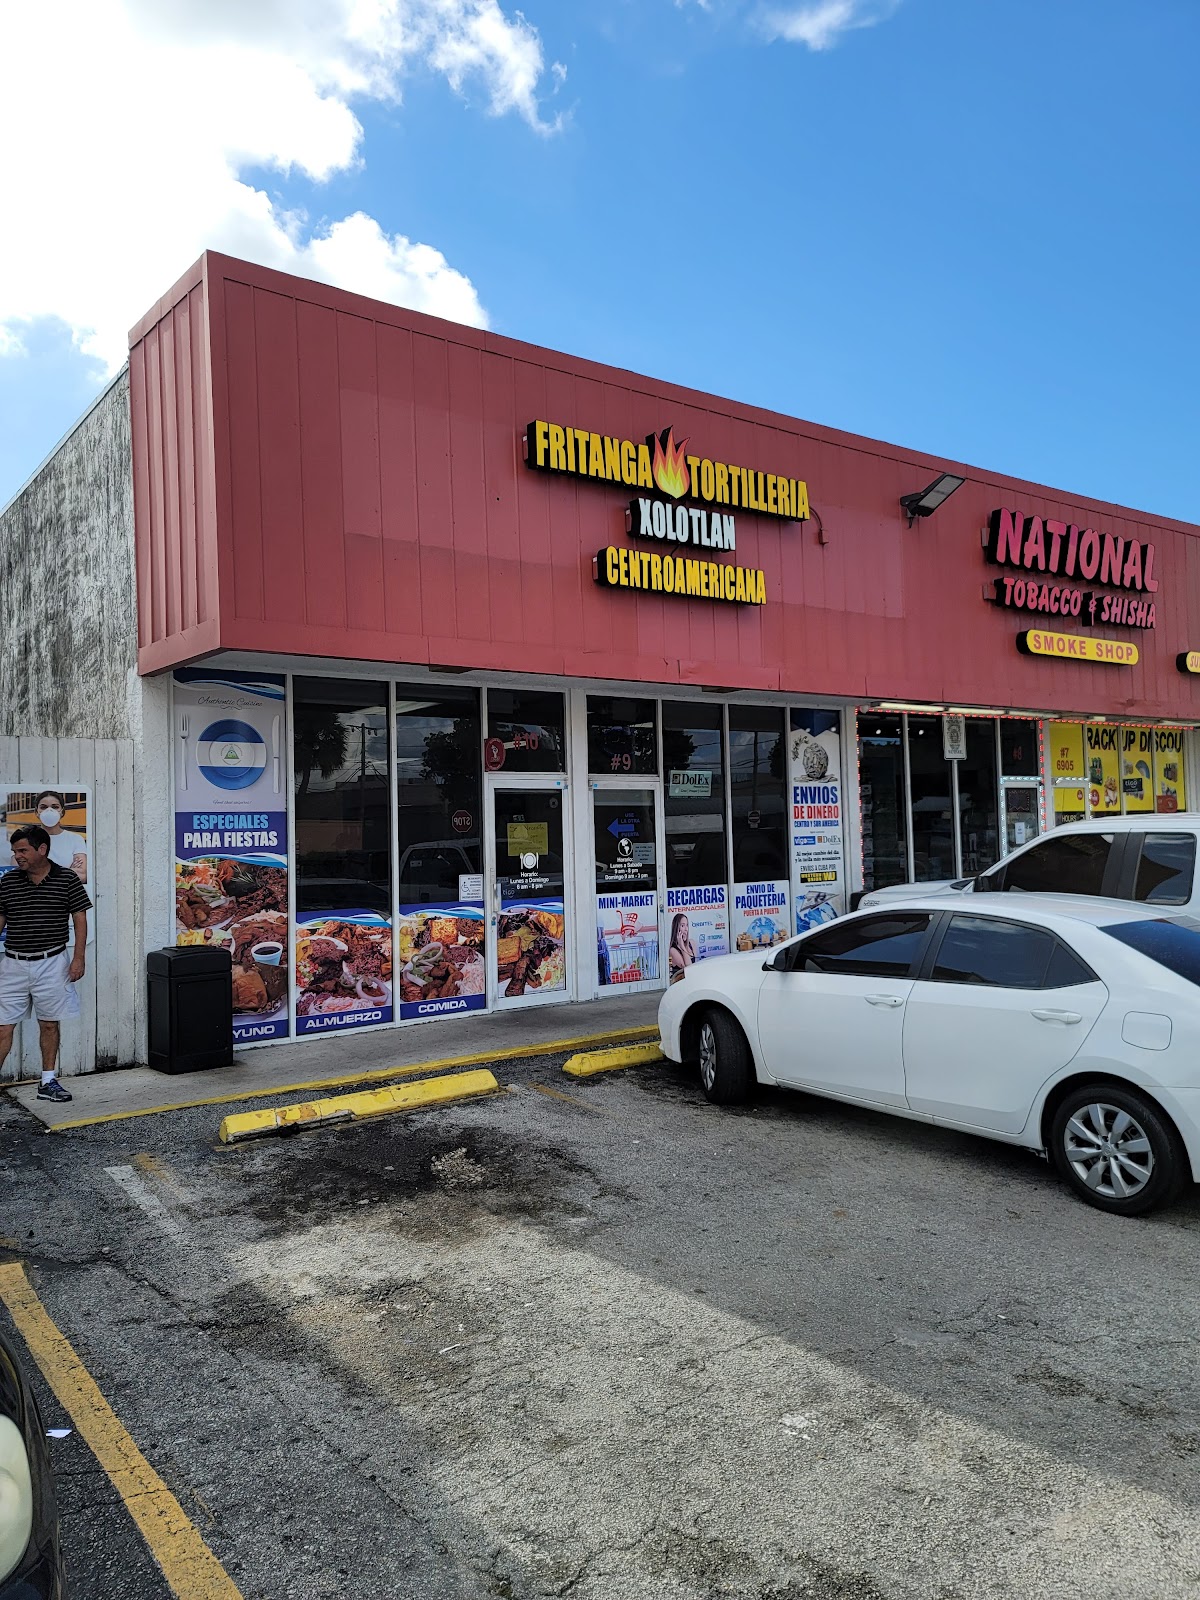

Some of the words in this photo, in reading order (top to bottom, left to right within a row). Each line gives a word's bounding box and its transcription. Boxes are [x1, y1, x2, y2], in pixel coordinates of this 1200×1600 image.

[535, 419, 654, 489] FRITANGA
[687, 455, 811, 520] TORTILLERIA
[638, 497, 736, 551] XOLOTLAN
[996, 507, 1159, 593] NATIONAL
[606, 545, 767, 605] CENTROAMERICANA
[1003, 577, 1081, 616] TOBACCO
[1101, 595, 1156, 629] SHISHA
[1033, 634, 1087, 656] SMOKE
[1096, 643, 1133, 661] SHOP
[1190, 655, 1200, 668] SU
[198, 696, 235, 705] Authentic
[236, 697, 263, 707] Cuisine
[513, 732, 538, 750] #10
[1060, 748, 1069, 759] #7
[611, 753, 631, 770] #9
[1057, 760, 1074, 771] 6905
[682, 773, 710, 785] DolEx
[793, 786, 838, 805] ENVIOS
[793, 806, 804, 819] DE
[807, 805, 839, 819] DINERO
[1061, 814, 1077, 823] HOURS
[193, 814, 269, 829] ESPECIALES
[794, 820, 809, 828] CENTRO
[822, 819, 839, 827] AMERICA
[183, 832, 221, 849] PARA
[224, 831, 278, 848] FIESTAS
[823, 835, 841, 844] DolEx
[746, 884, 766, 894] ENVIO
[767, 883, 775, 892] DE
[598, 895, 654, 909] MINI-MARKET
[667, 887, 725, 907] RECARGAS
[736, 893, 786, 909] PAQUETERIA
[667, 903, 726, 913] INTERNACIONALES
[743, 909, 760, 917] PUERTA
[764, 907, 780, 915] PUERTA
[418, 999, 468, 1014] COMIDA
[305, 1010, 382, 1029] ALMUERZO
